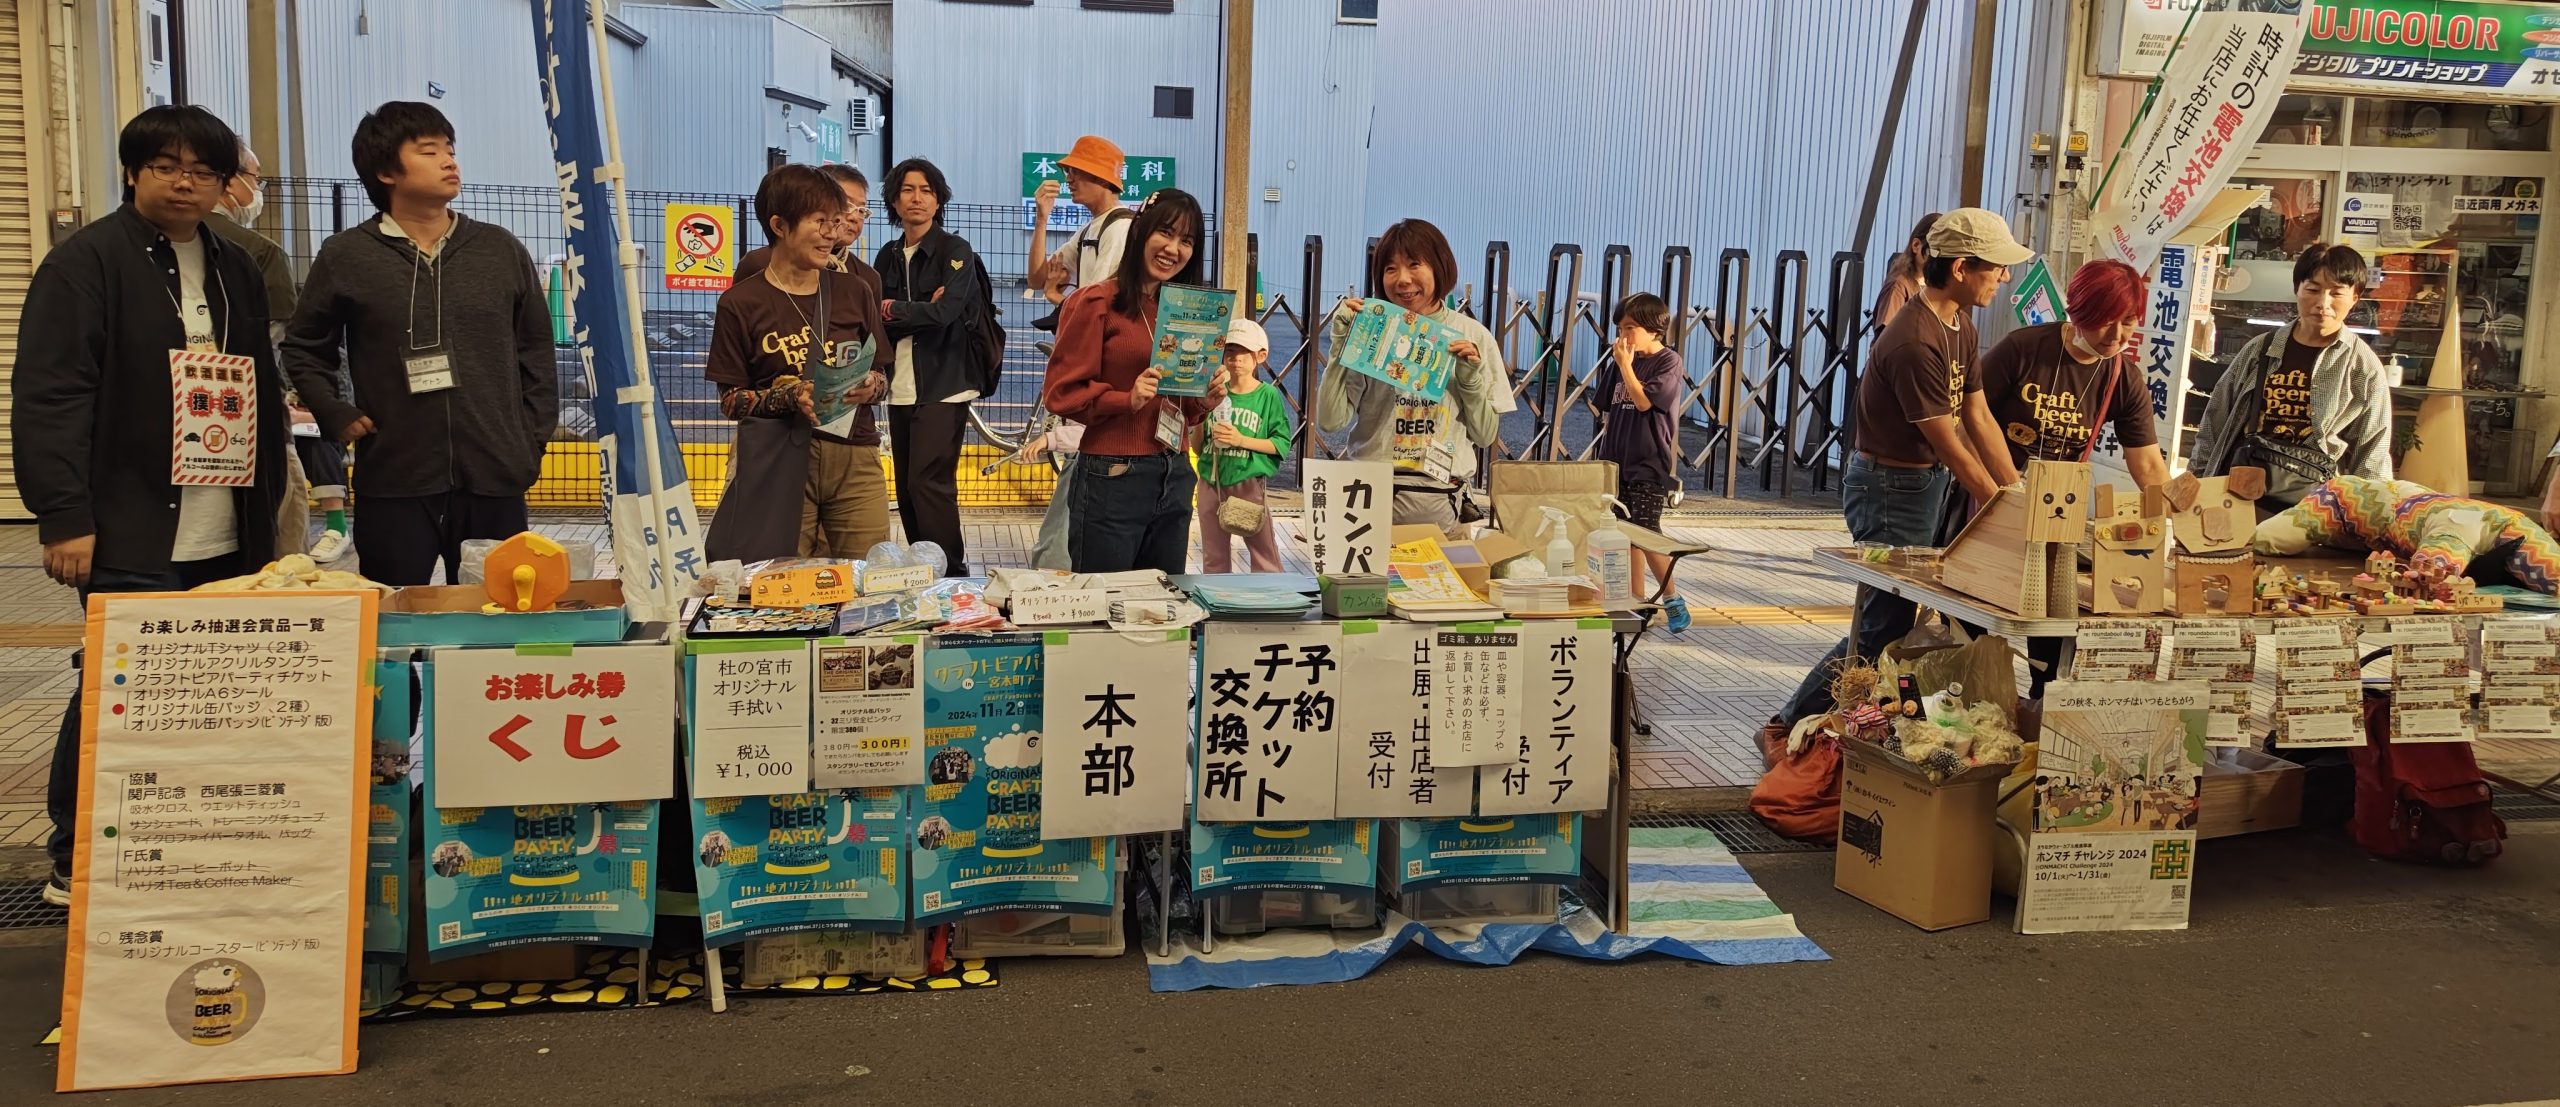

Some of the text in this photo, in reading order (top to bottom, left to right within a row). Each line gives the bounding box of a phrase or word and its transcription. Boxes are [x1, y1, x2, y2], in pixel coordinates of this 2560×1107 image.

[2309, 5, 2500, 50] UJICOLOR
[2135, 49, 2167, 57] IMAGING
[2138, 41, 2165, 49] DIGITAL
[2362, 56, 2488, 82] プリントショップ
[2454, 198, 2539, 211] 遠近両用 メガネ
[762, 326, 811, 354] Craf
[2146, 247, 2186, 421] 電池交換
[2021, 383, 2077, 410] Craft
[2034, 406, 2083, 425] beer
[1395, 418, 1435, 435] BEER
[1311, 475, 1328, 575] お願いします
[1342, 478, 1374, 574] カンパ
[139, 618, 325, 634] お楽しみ抽選会賞品一覧
[1440, 634, 1515, 645] ゴミ箱、ありません
[134, 656, 334, 671] オリジナルアクリルタンブラー
[718, 658, 793, 676] 杜の宮市
[934, 653, 1044, 685] クラフトビアパ
[133, 671, 332, 686] クラフトビアパーティチケット
[485, 672, 626, 701] お楽しみ券
[713, 679, 797, 696] オリジナル
[1479, 651, 1490, 722] 缶などは必ず、
[1292, 644, 1336, 733] 予約
[1444, 651, 1456, 735] 返却して下さい。
[728, 699, 782, 716] 手拭い
[1461, 651, 1473, 753] お買い求めのお店に
[1494, 651, 1507, 751] 皿や容器、コップや
[2059, 696, 2195, 707] この秋冬、ホンマチはいつもとちがう
[1548, 635, 1577, 804] ボランティア
[488, 714, 621, 762] くじ
[1204, 667, 1251, 802] 交換所
[1252, 643, 1293, 818] チケット
[1081, 684, 1137, 797] 本部
[737, 744, 770, 760] 税込
[1367, 731, 1396, 789] 受付
[129, 772, 158, 785] 協賛
[987, 780, 1041, 795] CRAFT
[128, 783, 286, 800] 関戸記念 西尾張三菱賞
[768, 793, 827, 808] CRAFT
[987, 793, 1041, 814] BEER
[769, 808, 827, 829] BEER
[986, 813, 1041, 830] PARTY
[514, 817, 577, 839] BEER
[769, 828, 826, 844] PARTY
[514, 838, 576, 855] PARTY
[2035, 849, 2147, 862] ホンマチ チャレンジ 2024
[252, 874, 294, 887] Maker
[119, 930, 163, 945] 残念賞
[195, 1003, 232, 1017] BEER
